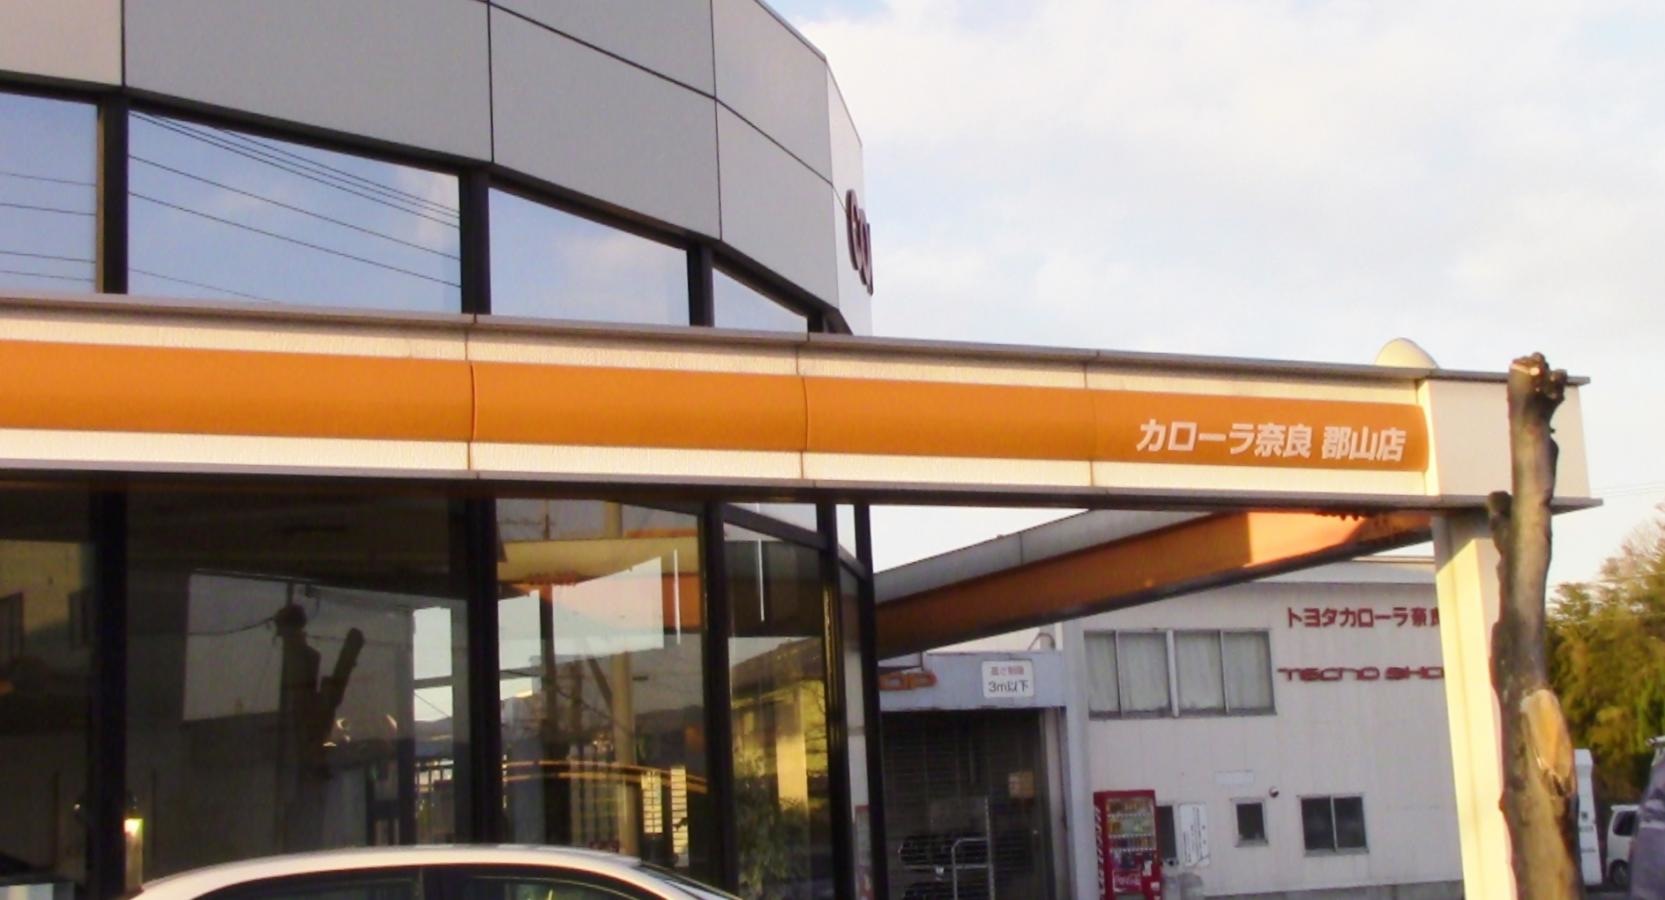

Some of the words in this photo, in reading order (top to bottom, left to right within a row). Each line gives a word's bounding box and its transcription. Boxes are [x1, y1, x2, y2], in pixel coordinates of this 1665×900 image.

[1136, 419, 1312, 458] カローラ奈良
[1321, 426, 1407, 462] 郡山店
[1277, 666, 1380, 682] TECNO
